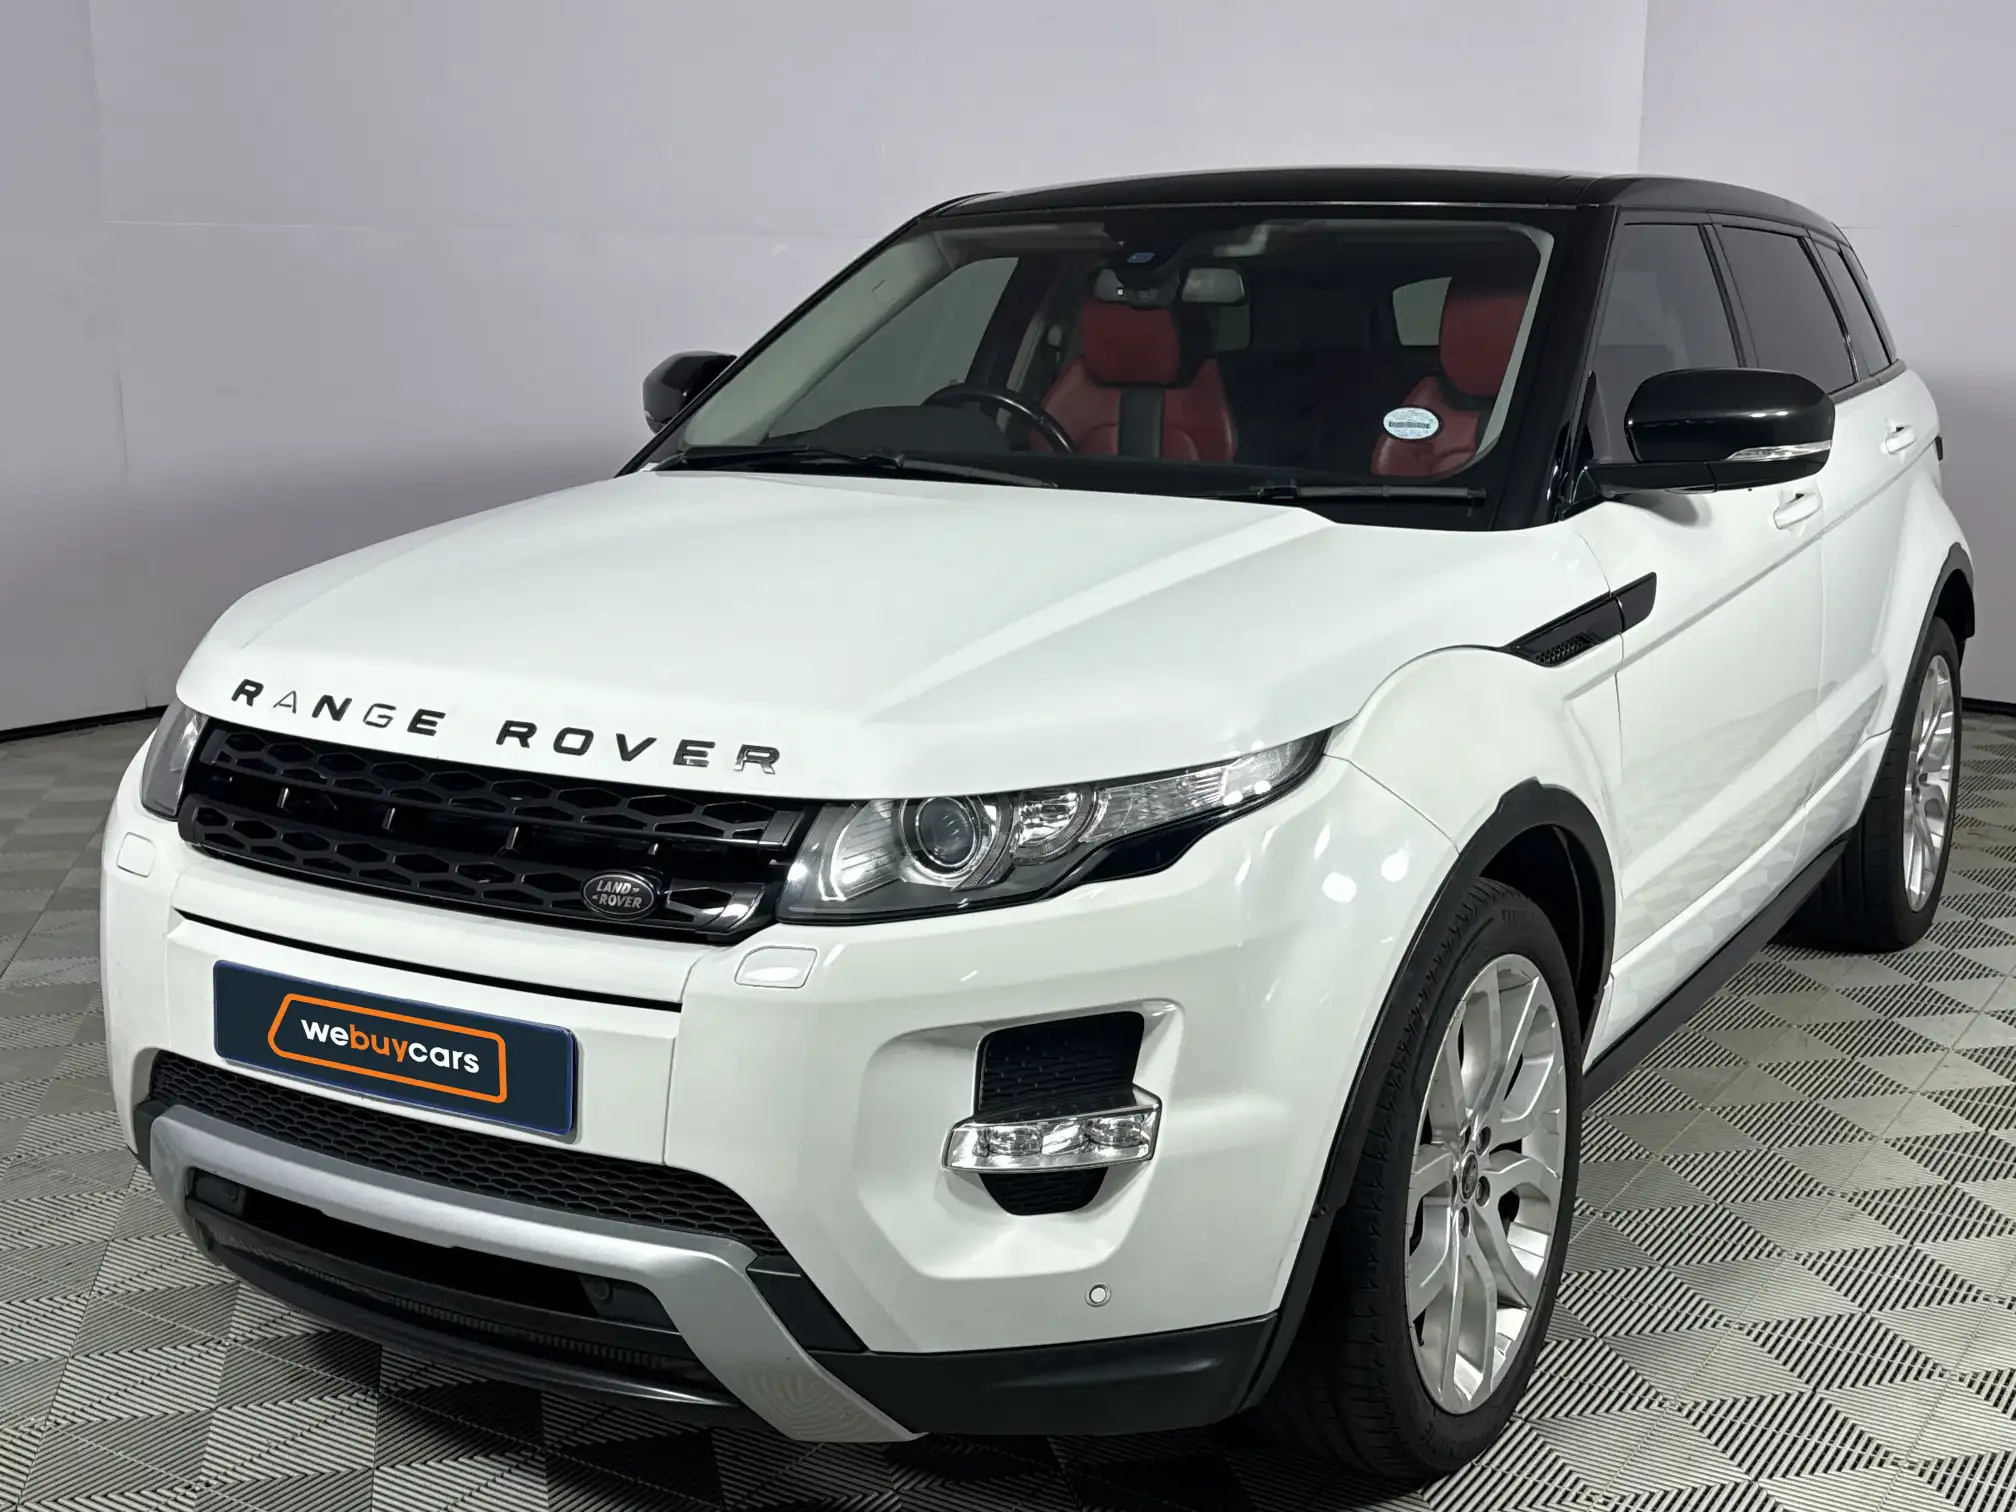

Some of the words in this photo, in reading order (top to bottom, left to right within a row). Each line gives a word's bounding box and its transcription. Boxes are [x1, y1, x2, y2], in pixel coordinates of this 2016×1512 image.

[231, 678, 447, 737] RANGE
[496, 719, 780, 775] ROVER
[596, 880, 632, 895] LAND
[598, 893, 643, 909] ROVER
[301, 1018, 480, 1074] webuycars
